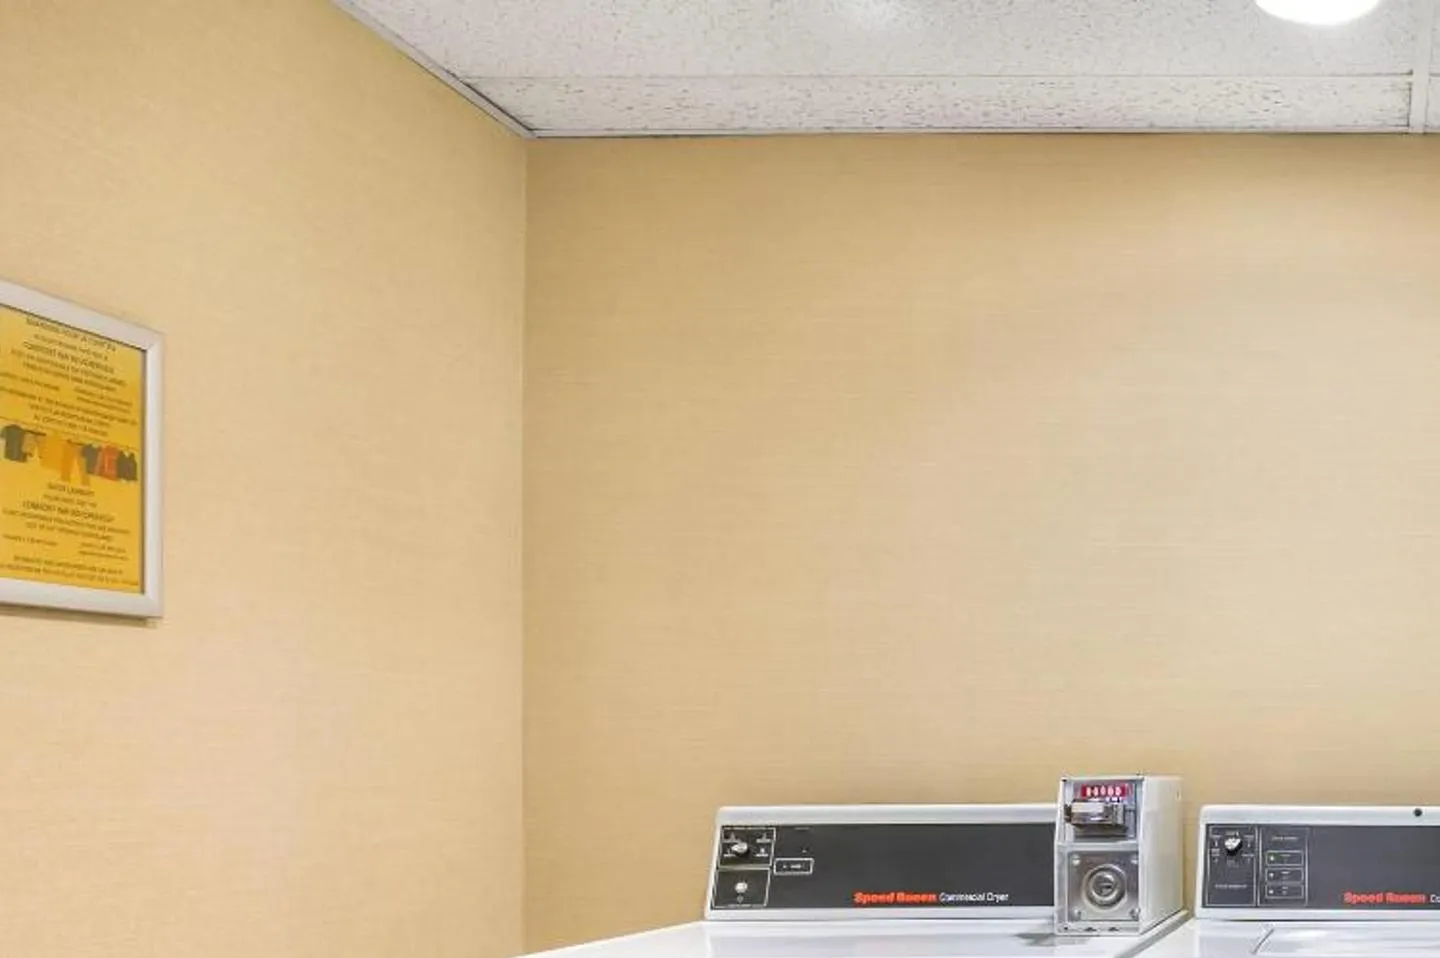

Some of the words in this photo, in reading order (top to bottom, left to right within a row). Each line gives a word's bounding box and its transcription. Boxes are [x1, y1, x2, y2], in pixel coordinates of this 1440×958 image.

[854, 891, 895, 904] Speed
[896, 891, 937, 903] Queen
[938, 892, 986, 903] Commercial
[986, 892, 1009, 904] Dryer
[1343, 892, 1384, 905] Speed
[1385, 892, 1426, 904] Queen
